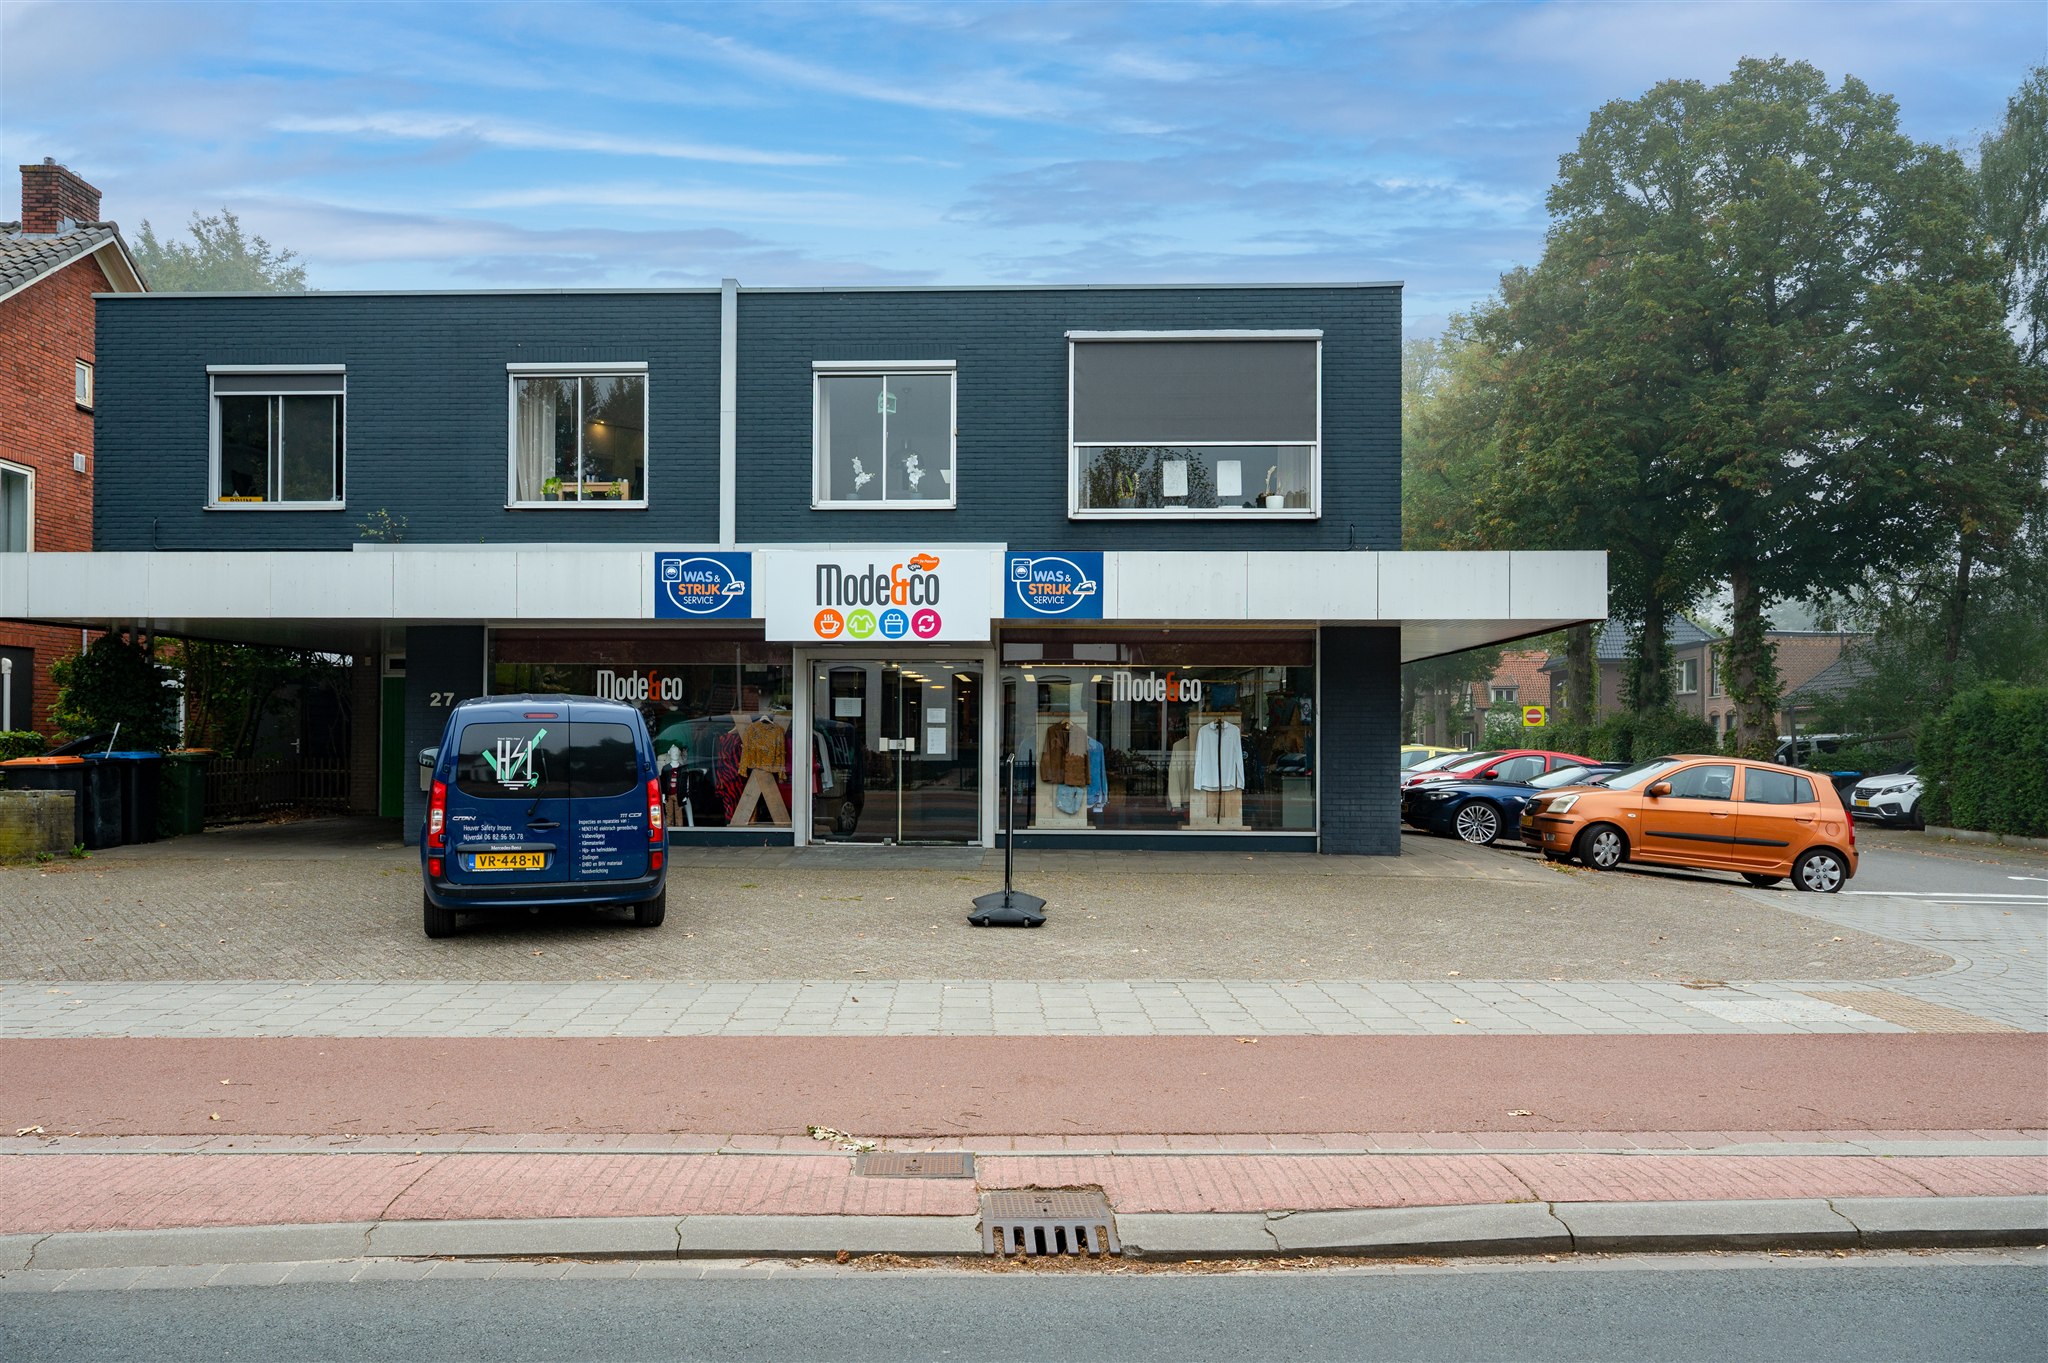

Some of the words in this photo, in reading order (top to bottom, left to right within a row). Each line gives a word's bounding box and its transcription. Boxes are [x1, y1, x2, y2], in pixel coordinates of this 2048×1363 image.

[683, 571, 713, 583] WAS
[714, 575, 720, 583] &
[1033, 571, 1064, 582] WAS
[678, 583, 720, 595] STRIJK
[816, 563, 940, 606] Mode&co
[1028, 583, 1071, 595] STRIJK
[683, 596, 714, 605] SERVICE
[1033, 596, 1064, 605] SERVICE
[597, 669, 683, 701] Mode&co
[1113, 671, 1202, 702] Mode&co
[430, 692, 455, 707] 27
[479, 854, 541, 867] VR-448-N
